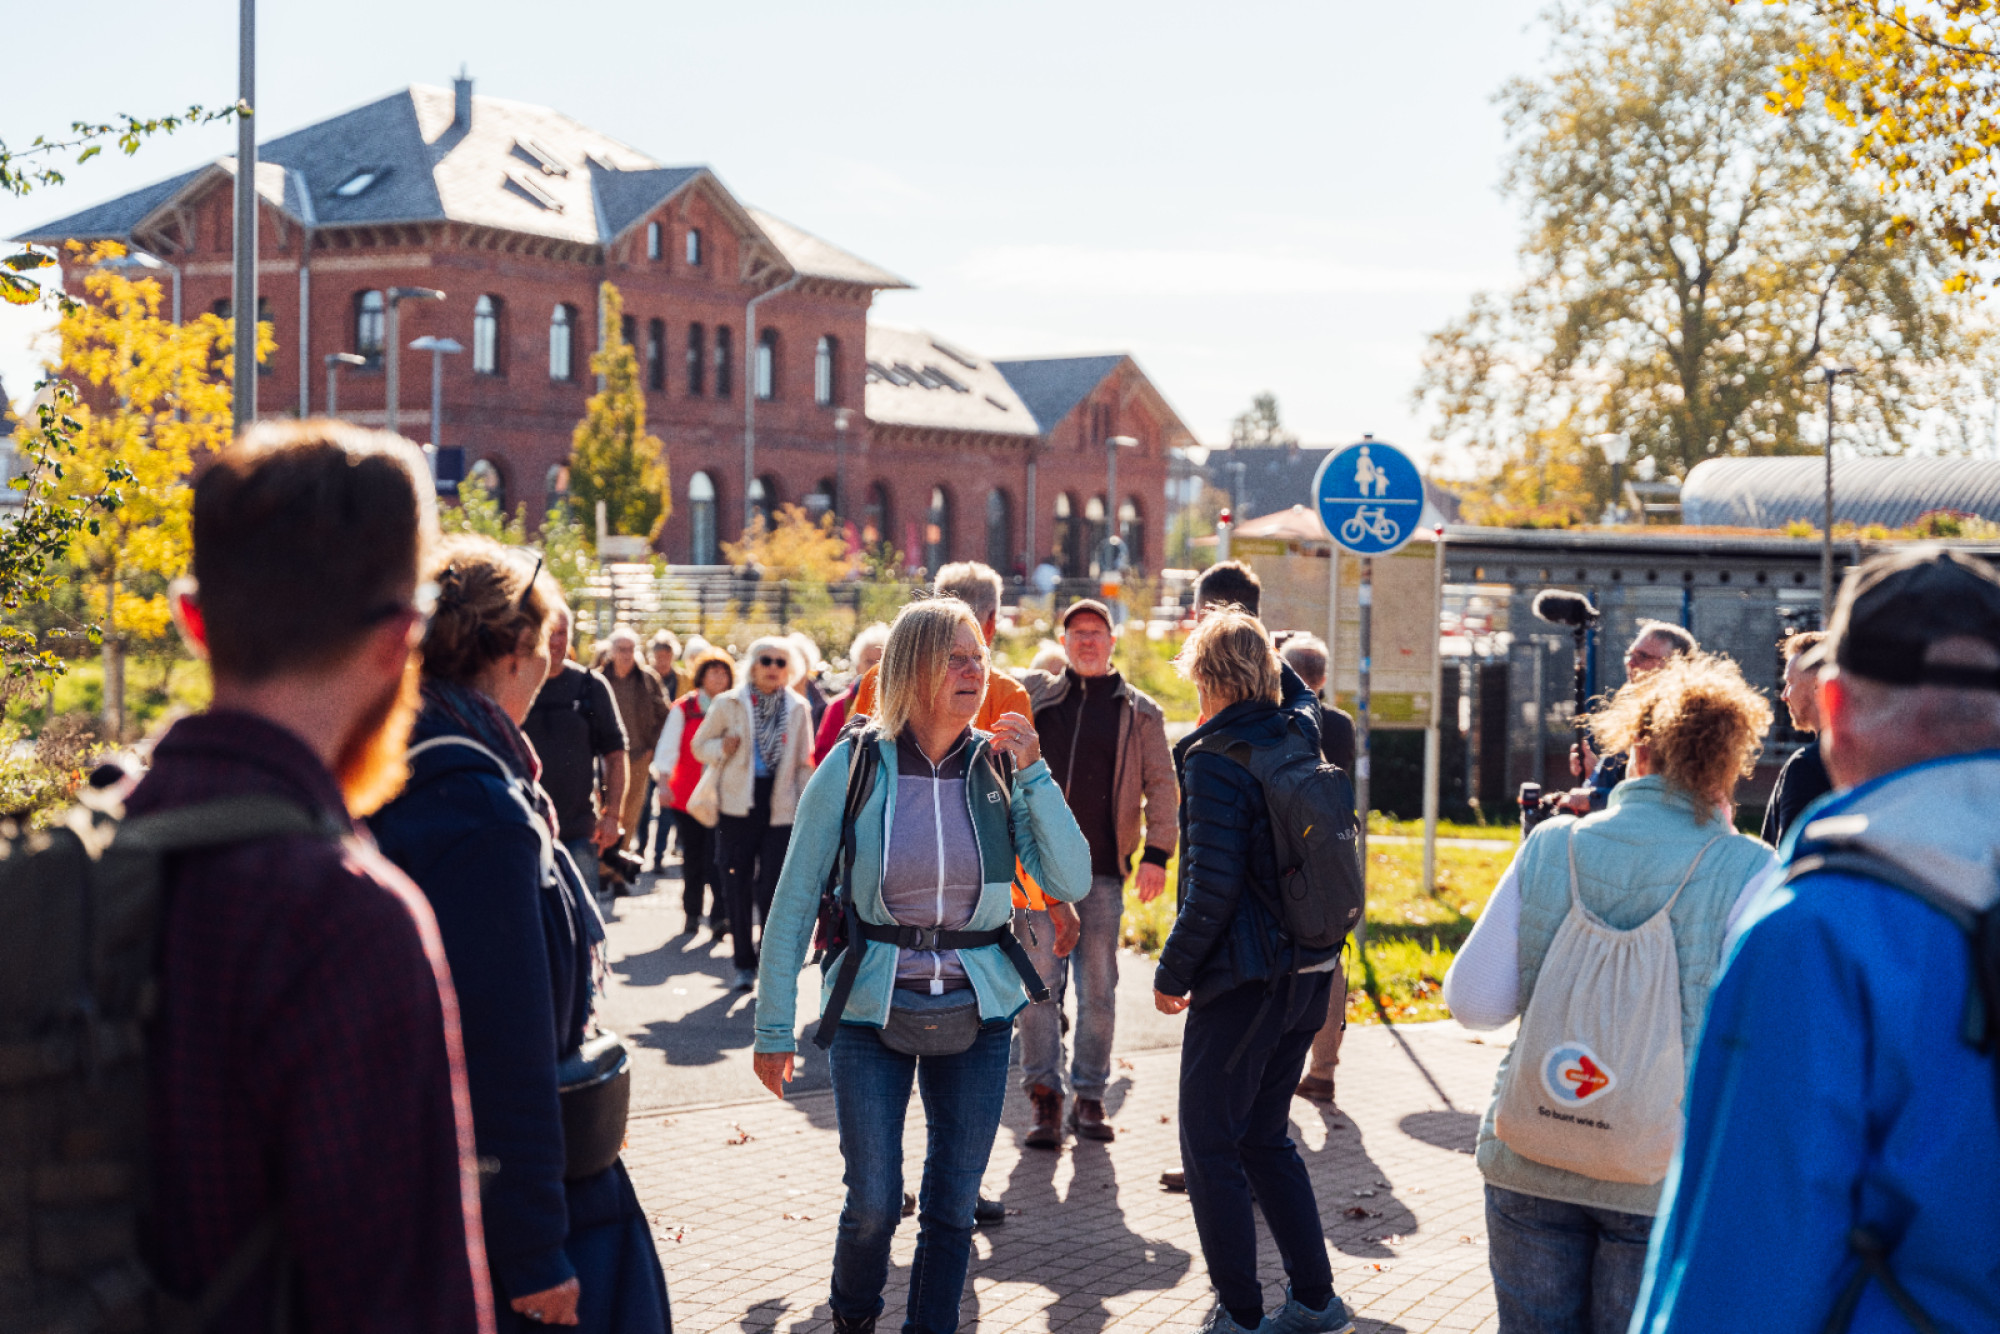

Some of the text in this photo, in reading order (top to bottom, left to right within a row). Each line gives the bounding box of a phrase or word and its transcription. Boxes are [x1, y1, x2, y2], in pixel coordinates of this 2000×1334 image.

[1539, 1106, 1612, 1130] So bunt wie du.
